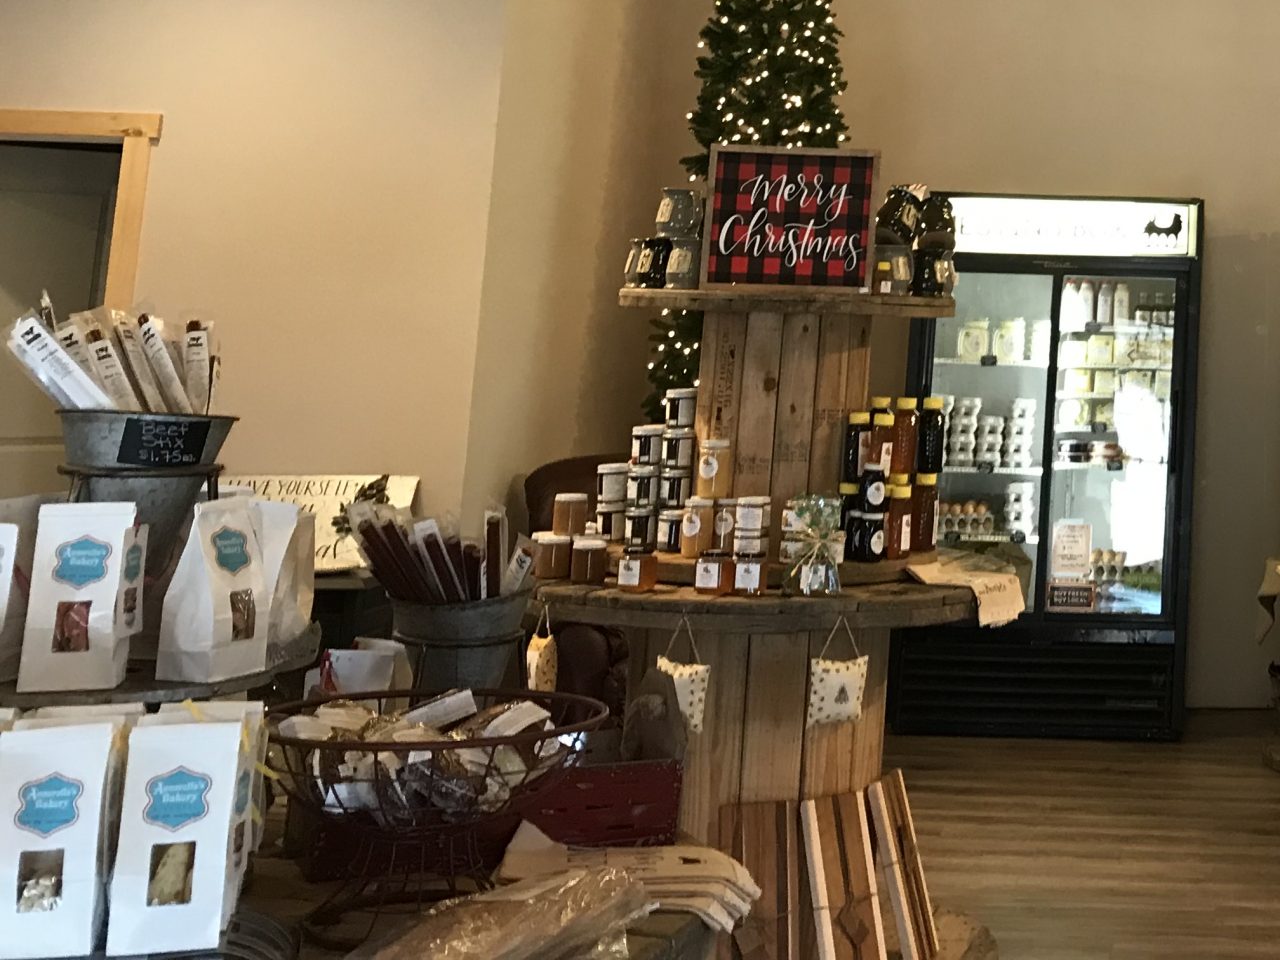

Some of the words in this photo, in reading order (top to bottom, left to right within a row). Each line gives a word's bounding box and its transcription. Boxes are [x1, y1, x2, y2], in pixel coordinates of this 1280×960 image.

[739, 173, 853, 229] Merry
[718, 207, 863, 272] Christmas
[141, 421, 188, 436] Beef
